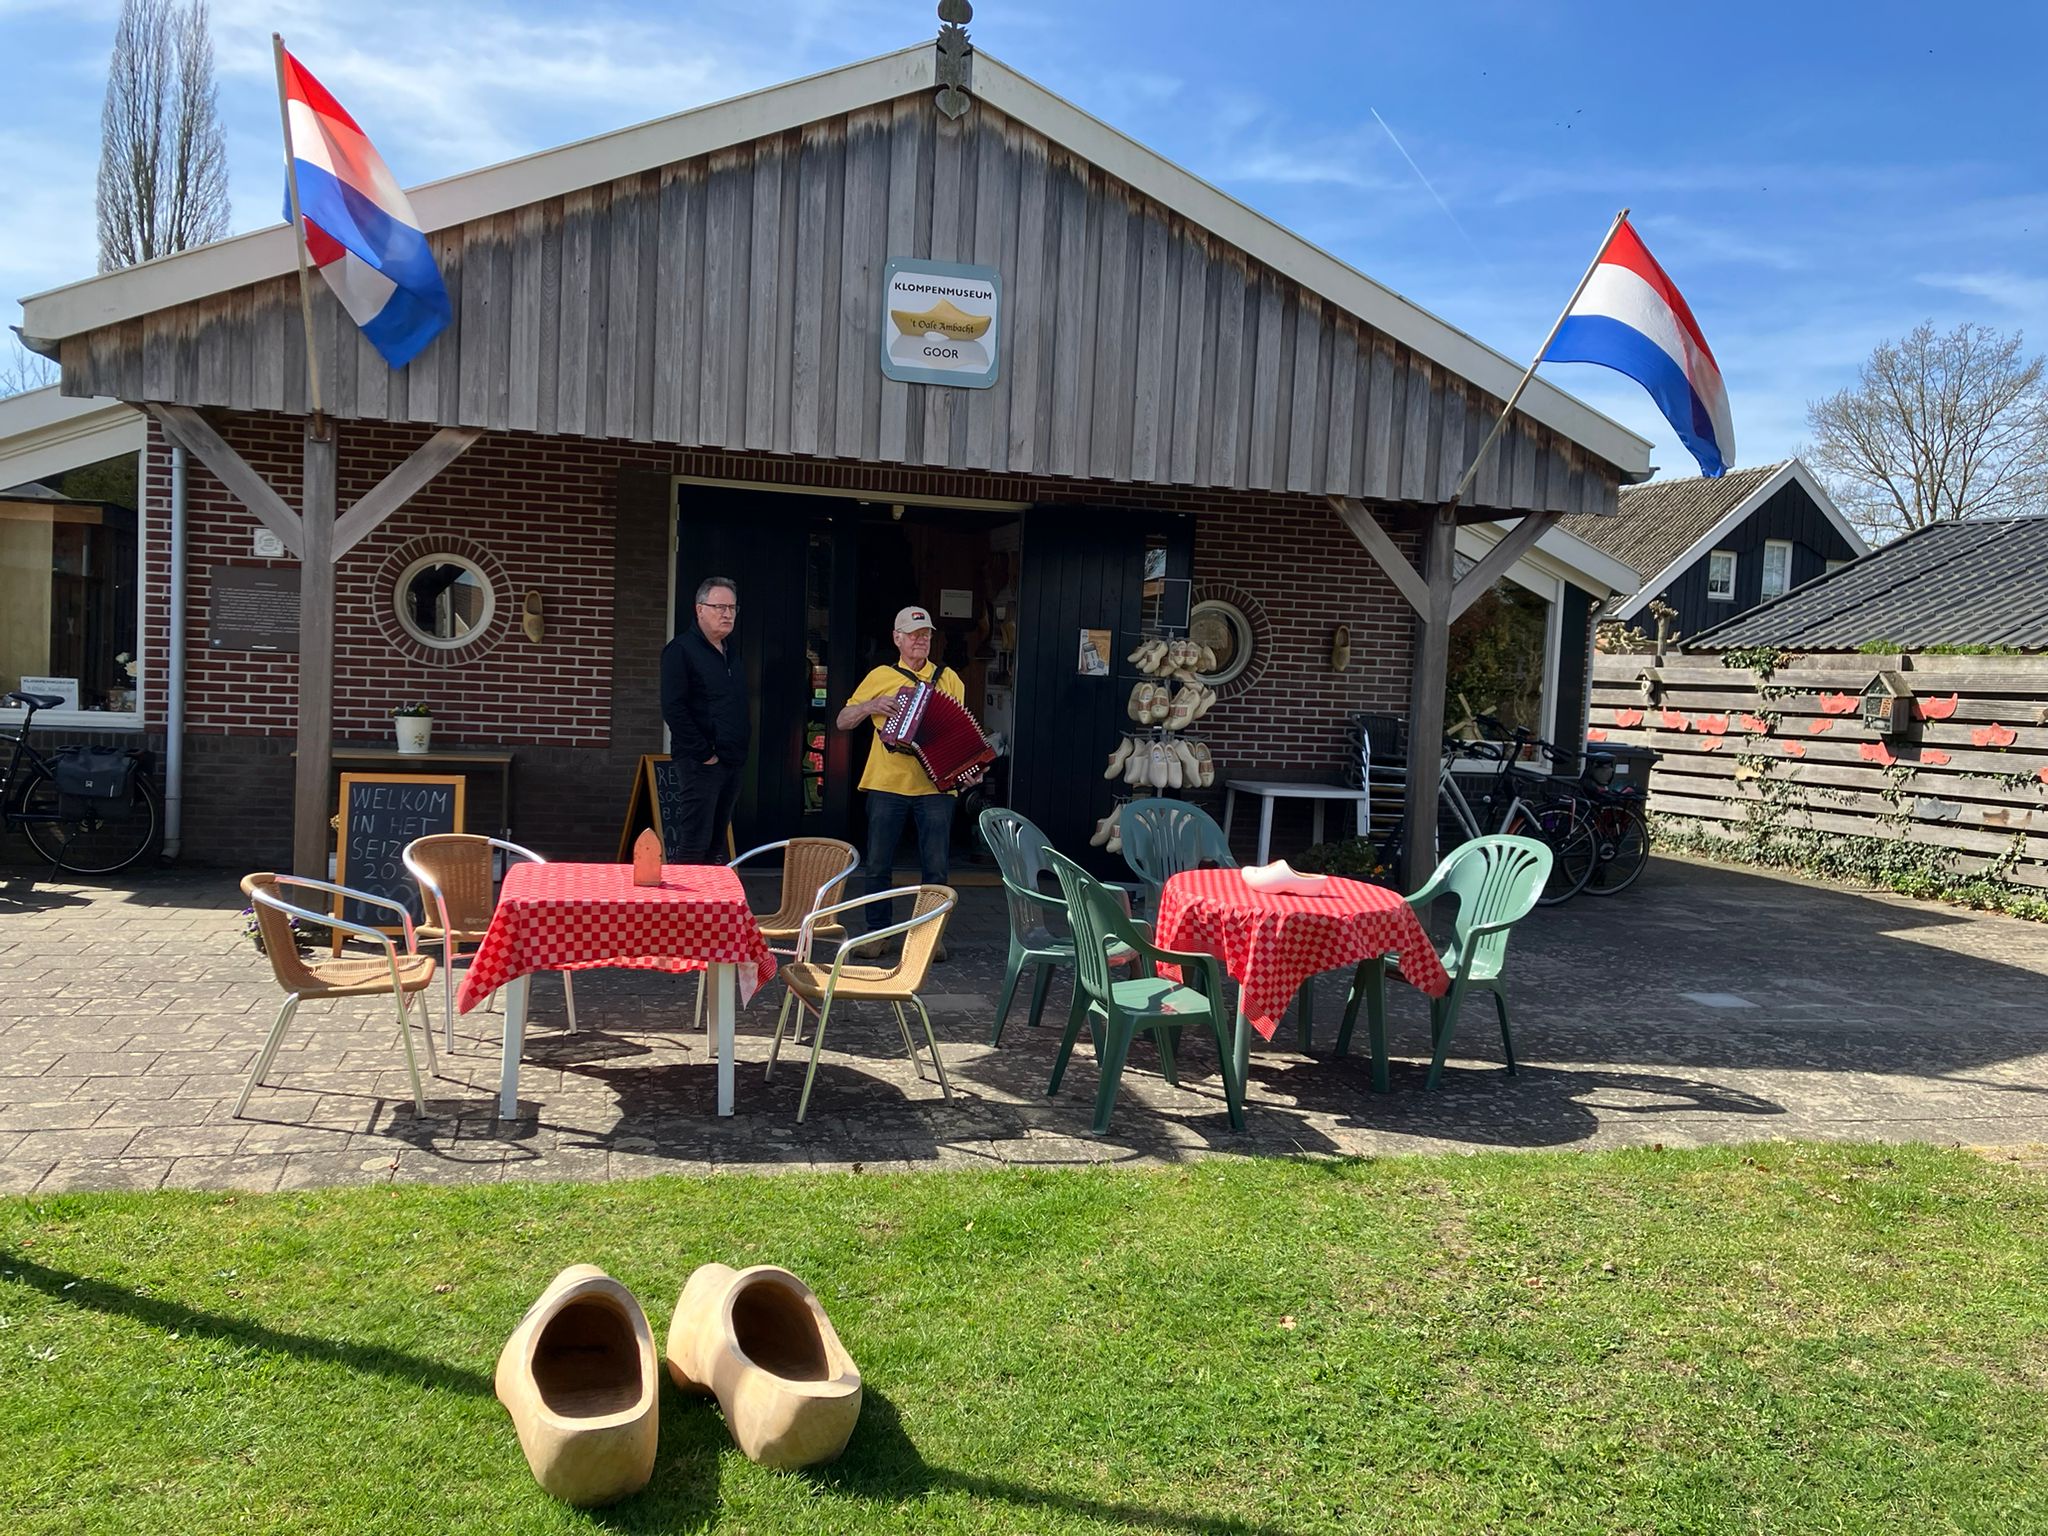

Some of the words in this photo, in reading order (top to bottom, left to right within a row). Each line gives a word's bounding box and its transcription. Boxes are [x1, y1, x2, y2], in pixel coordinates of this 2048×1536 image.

[894, 282, 992, 300] KLOMPENMUSEUM
[938, 322, 974, 333] Ambacht
[923, 347, 959, 359] GOOR
[352, 787, 448, 813] WELKOM
[389, 816, 439, 836] HET
[351, 836, 402, 860] SEIZ
